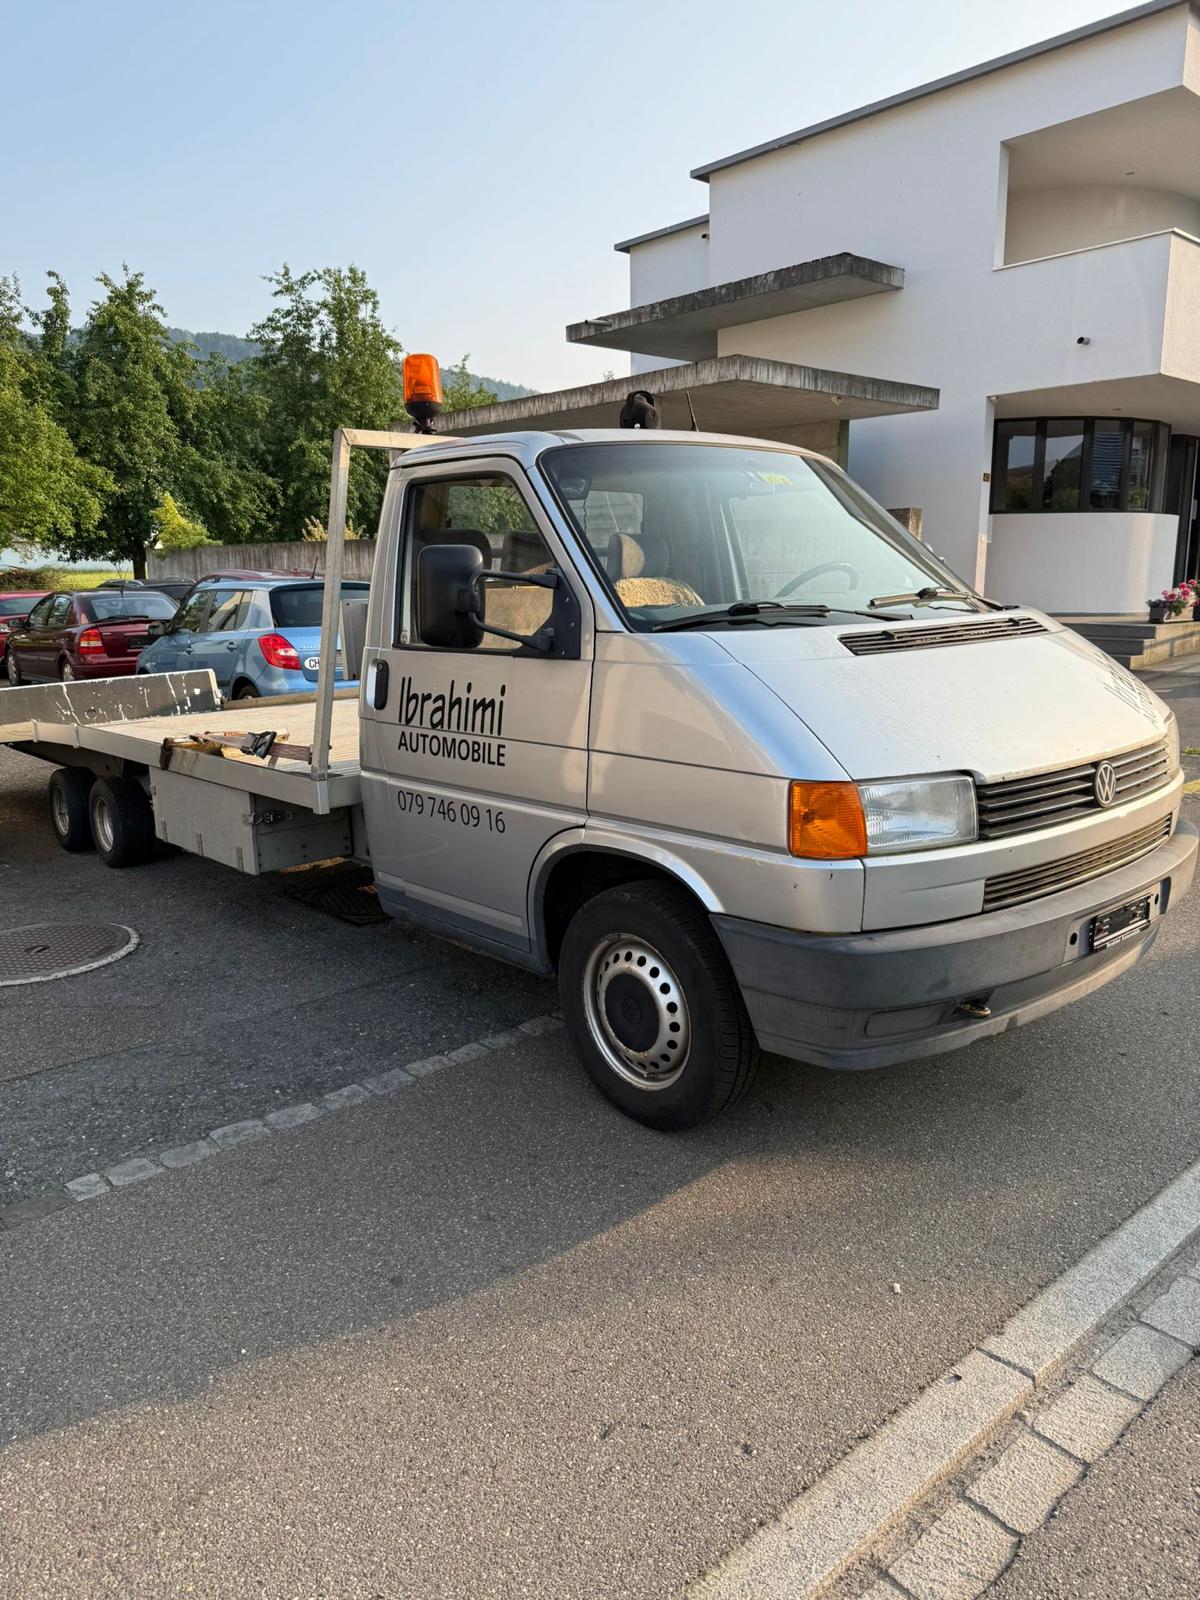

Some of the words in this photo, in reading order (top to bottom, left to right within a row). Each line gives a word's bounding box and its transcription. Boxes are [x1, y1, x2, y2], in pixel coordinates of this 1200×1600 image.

[308, 658, 319, 668] CH
[398, 676, 506, 736] Ibrahimi
[397, 730, 506, 767] AUTOMOBILE
[397, 790, 424, 815] 079
[427, 796, 457, 823] 746
[460, 802, 480, 828] 09
[485, 808, 506, 834] 16
